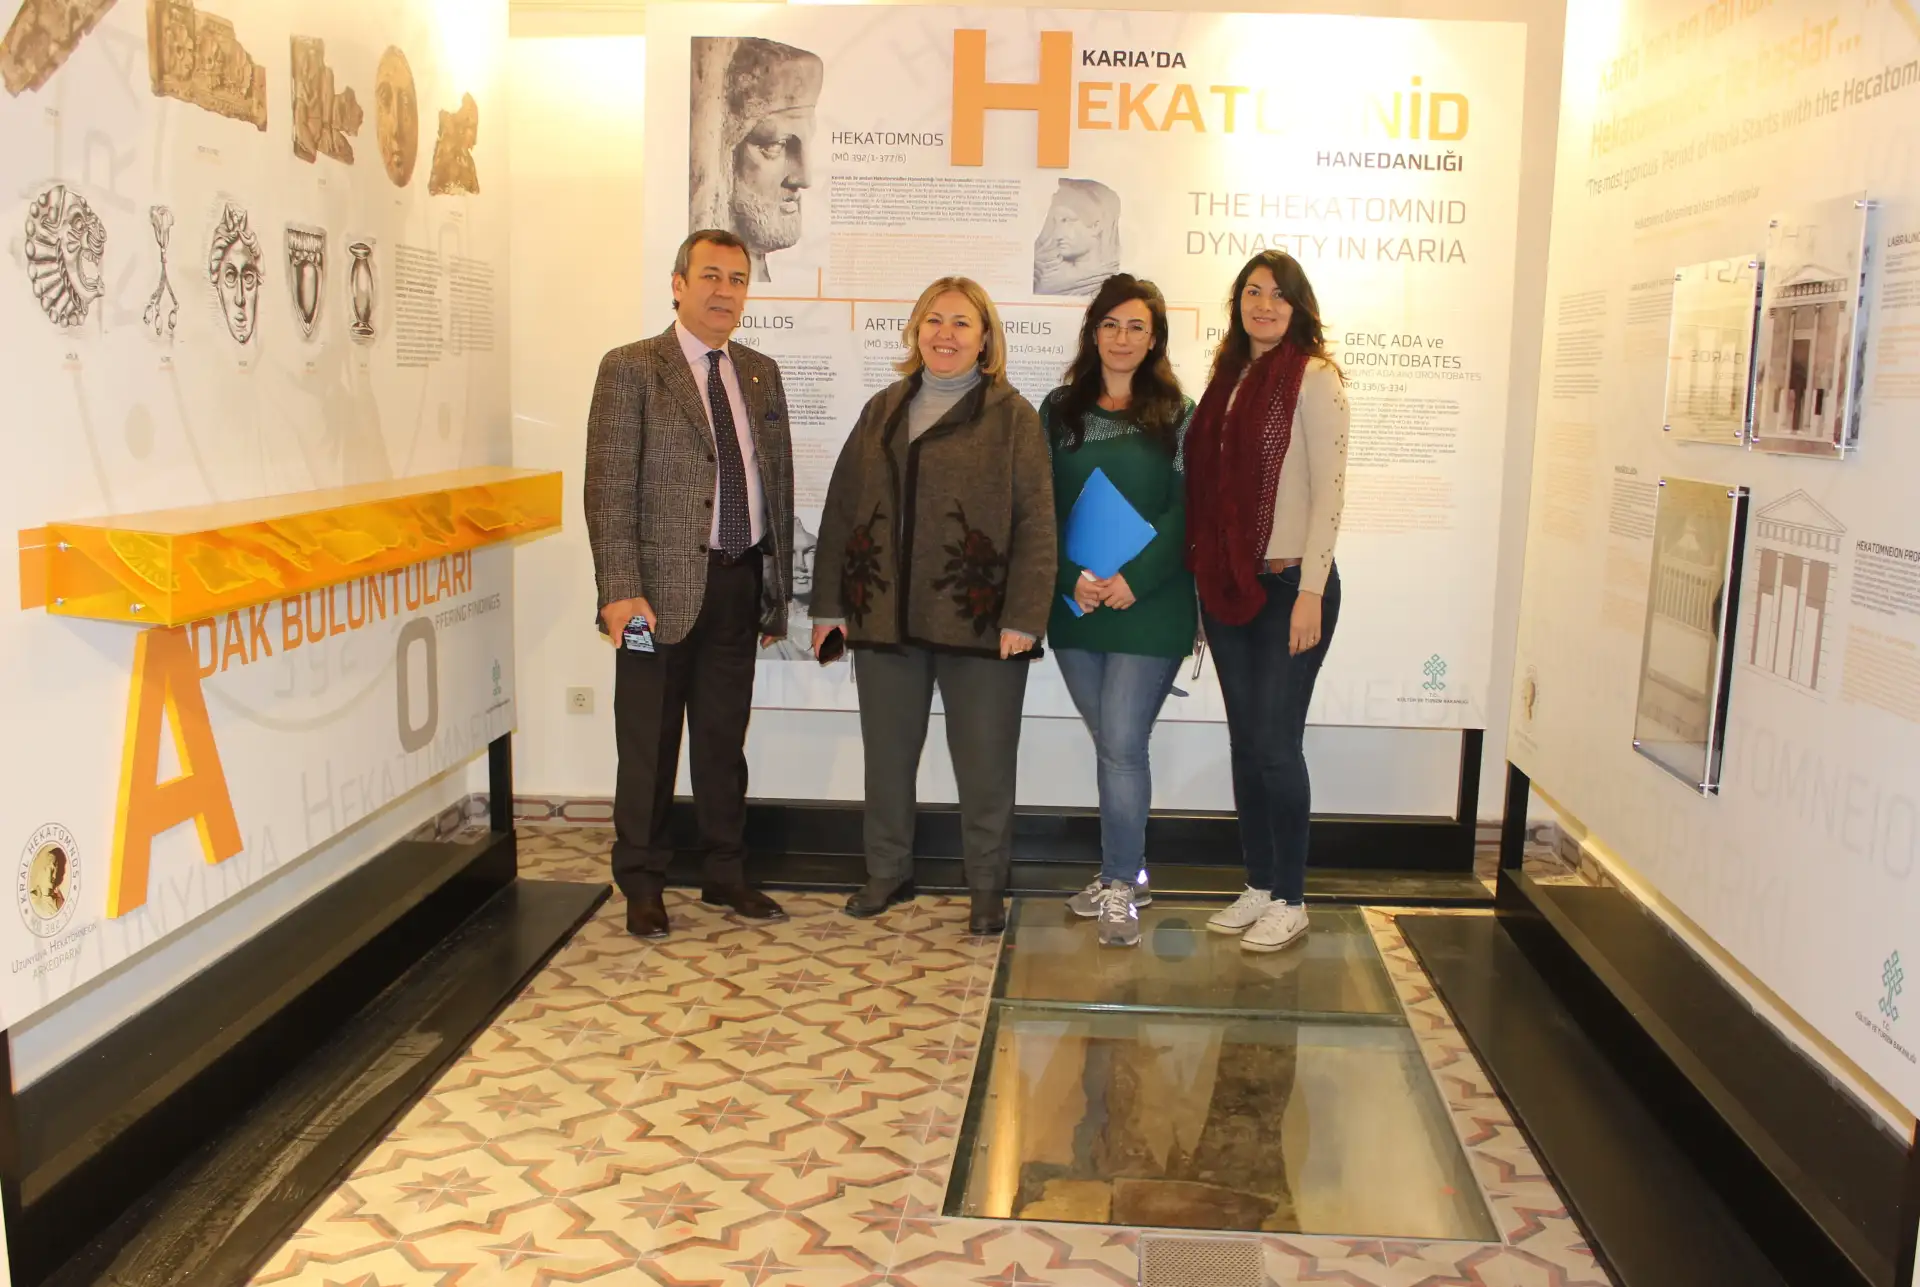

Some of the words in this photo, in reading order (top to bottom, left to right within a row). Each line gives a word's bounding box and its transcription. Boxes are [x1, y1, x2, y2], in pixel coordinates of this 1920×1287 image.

[1081, 48, 1187, 70] KARIA'DA
[1742, 110, 1780, 144] Starts
[1782, 94, 1812, 130] with
[1815, 87, 1840, 118] the
[1843, 59, 1920, 109] Hecatom
[831, 131, 945, 148] HEKATOMNOS
[831, 152, 850, 164] (MÖ
[1316, 149, 1463, 172] HANEDANLIĞI
[1187, 191, 1251, 218] THE
[1260, 193, 1467, 226] HEKATOMNID
[1186, 231, 1328, 260] DYNASTY
[1337, 234, 1368, 261] IN
[1376, 236, 1467, 265] KARIA
[864, 317, 909, 331] ARTE
[1001, 320, 1051, 335] RIEUS
[864, 338, 881, 350] (MÖ
[1345, 331, 1387, 350] GENÇ
[1390, 333, 1423, 349] ADA
[1427, 336, 1444, 349] ve
[1344, 352, 1462, 370] ORONTOBATES
[1856, 540, 1903, 560] HEKATOMNEION
[19, 860, 29, 905] KRAL
[28, 826, 80, 880] HEKATOMNOS
